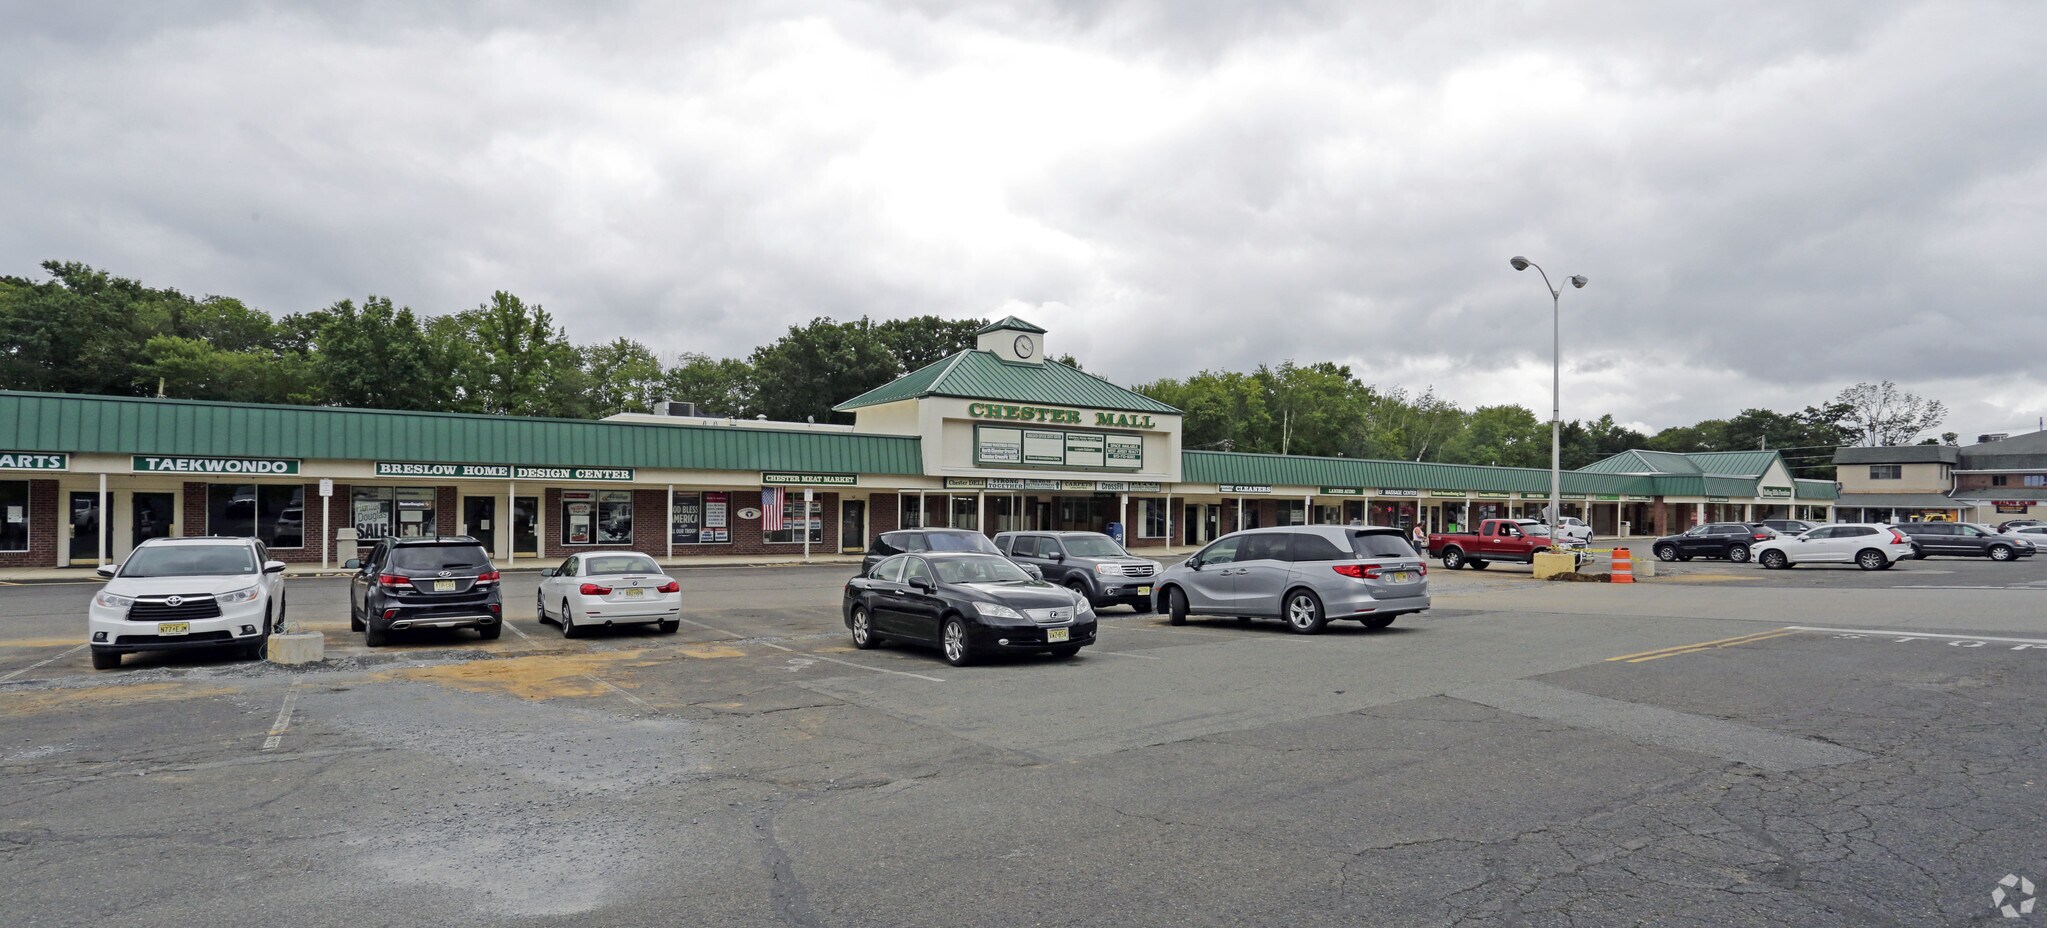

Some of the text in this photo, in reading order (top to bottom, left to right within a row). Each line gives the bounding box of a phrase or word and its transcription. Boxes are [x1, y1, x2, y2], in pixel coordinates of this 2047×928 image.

[968, 402, 1156, 429] CHESTER MALL
[0, 454, 61, 468] ARTS
[146, 458, 288, 473] TAEKWONDO
[379, 463, 631, 480] BRESLOW HOME DESIGN CENTER
[765, 474, 800, 482] CHESTER
[801, 475, 822, 483] MEAT
[1235, 485, 1271, 493] CLEANERS
[358, 511, 387, 522] Douglas
[682, 506, 699, 514] BLESS
[356, 523, 388, 539] SALE
